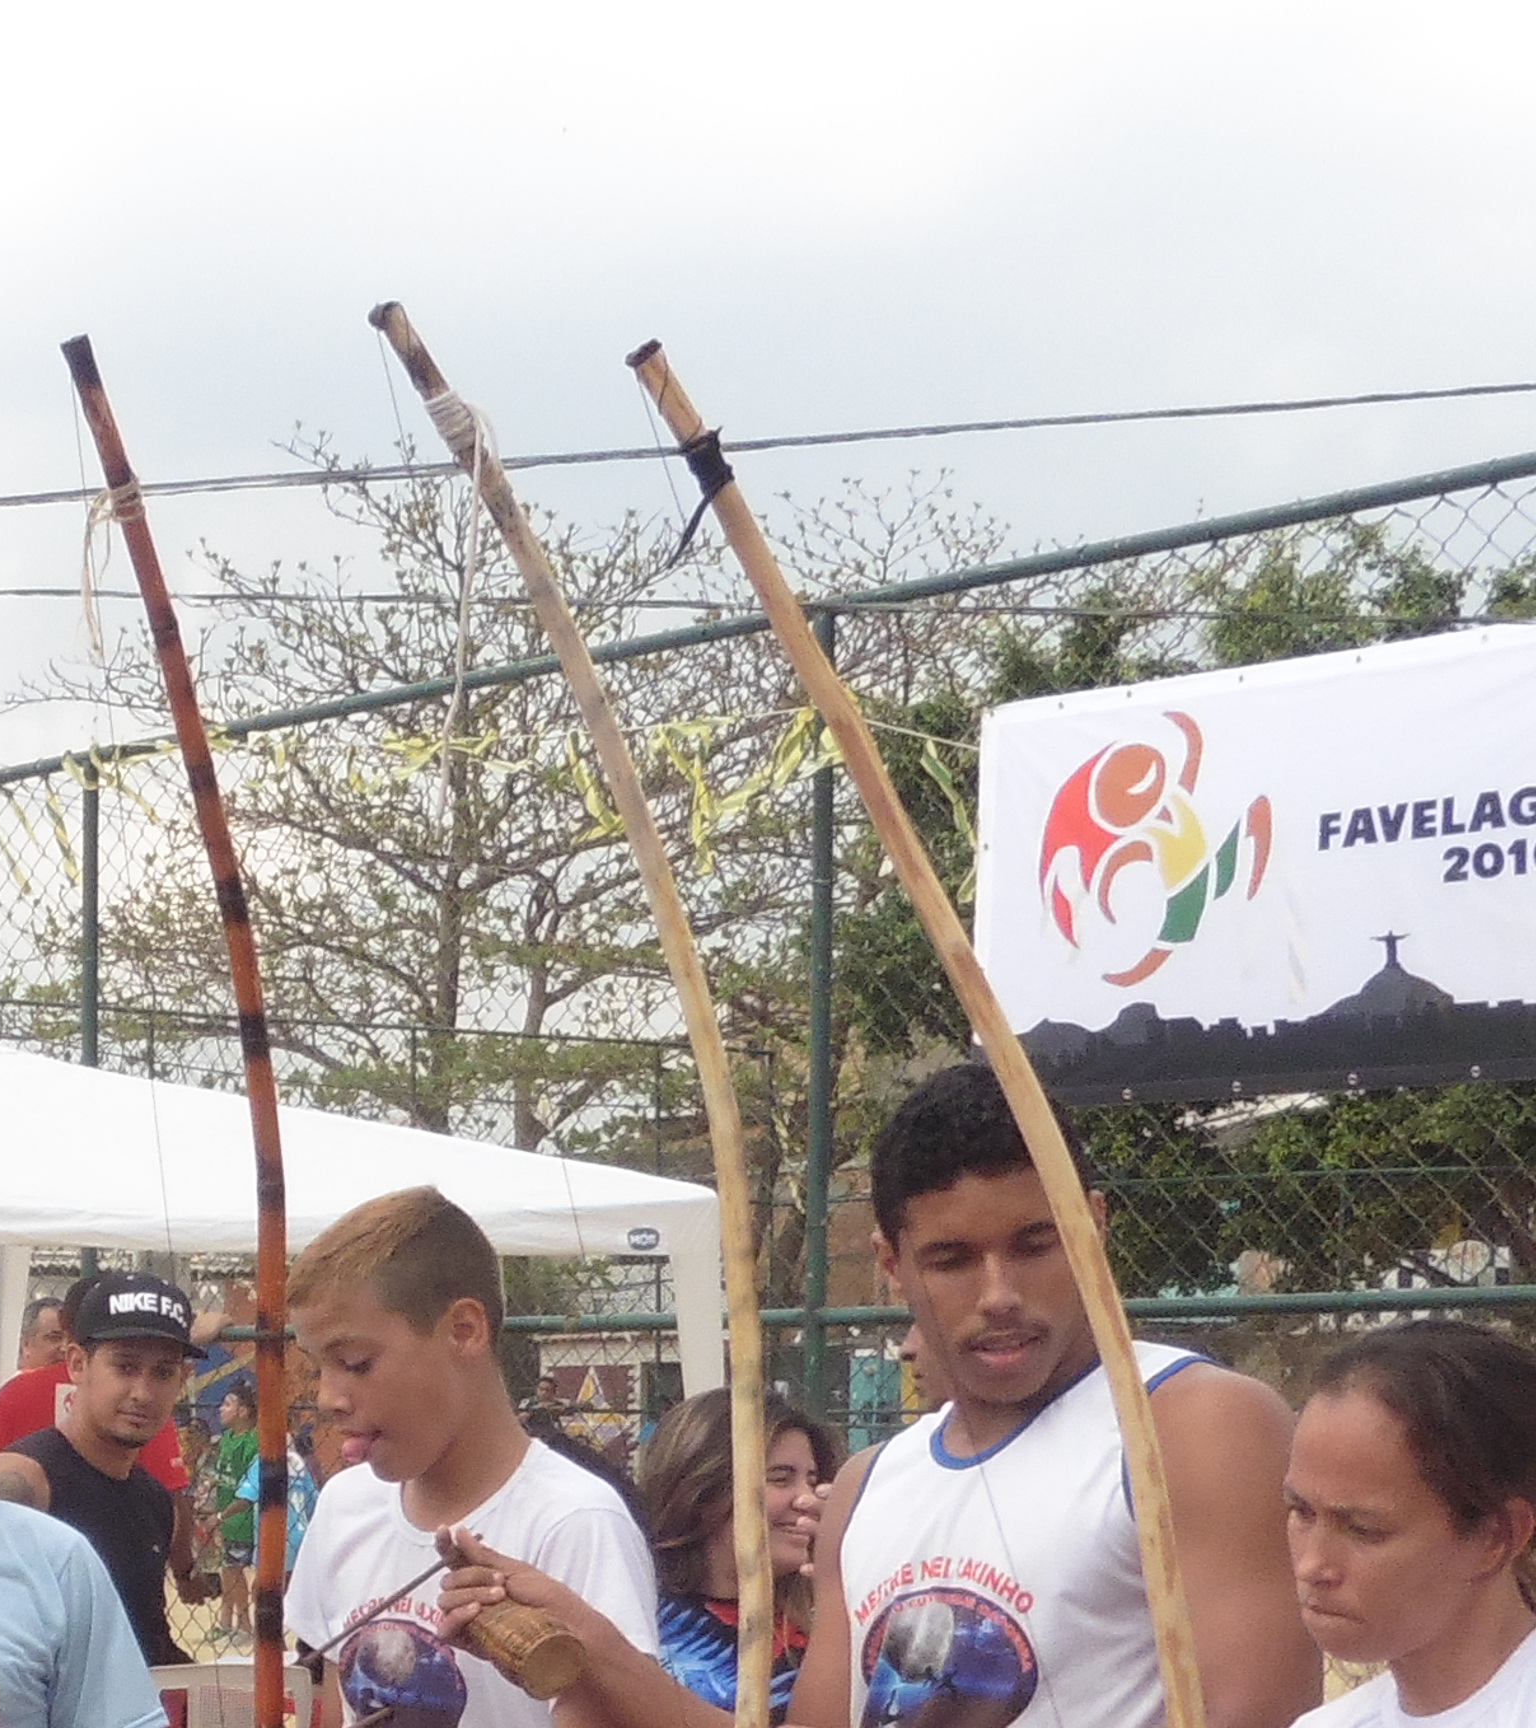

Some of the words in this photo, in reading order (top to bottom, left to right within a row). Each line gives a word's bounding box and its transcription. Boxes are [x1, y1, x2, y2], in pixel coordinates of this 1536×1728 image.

[1443, 838, 1536, 883] 201
[109, 1291, 159, 1316] NIKE
[159, 1295, 188, 1329] F.C.
